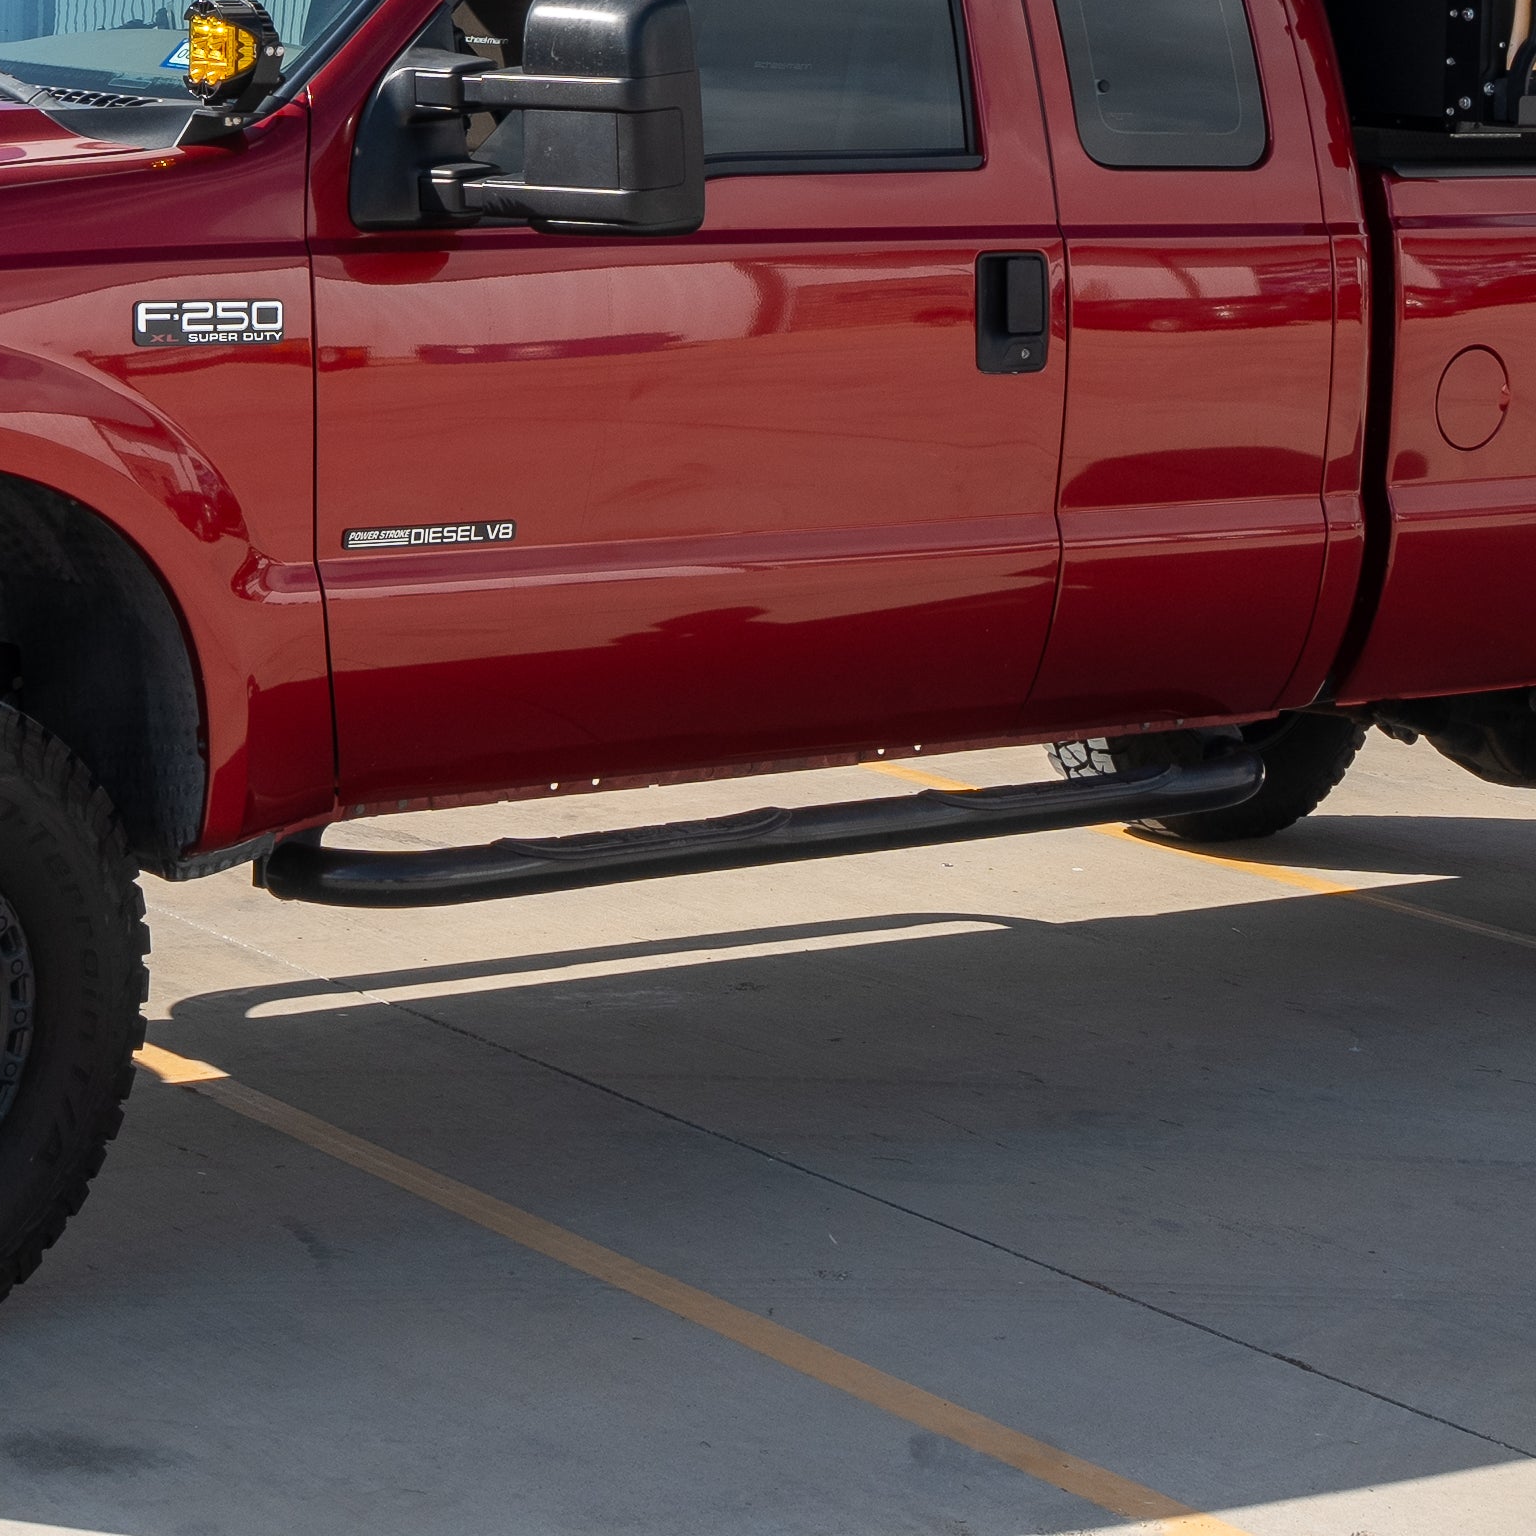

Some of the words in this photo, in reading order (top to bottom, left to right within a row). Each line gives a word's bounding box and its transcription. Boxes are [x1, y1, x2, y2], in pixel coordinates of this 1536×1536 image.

[150, 334, 180, 343] XL
[188, 332, 238, 343] SUPER
[242, 331, 283, 342] DUTY
[348, 530, 379, 541] POWER
[379, 529, 411, 539] STROKE
[410, 525, 484, 545] DIESEL
[486, 523, 513, 540] V8
